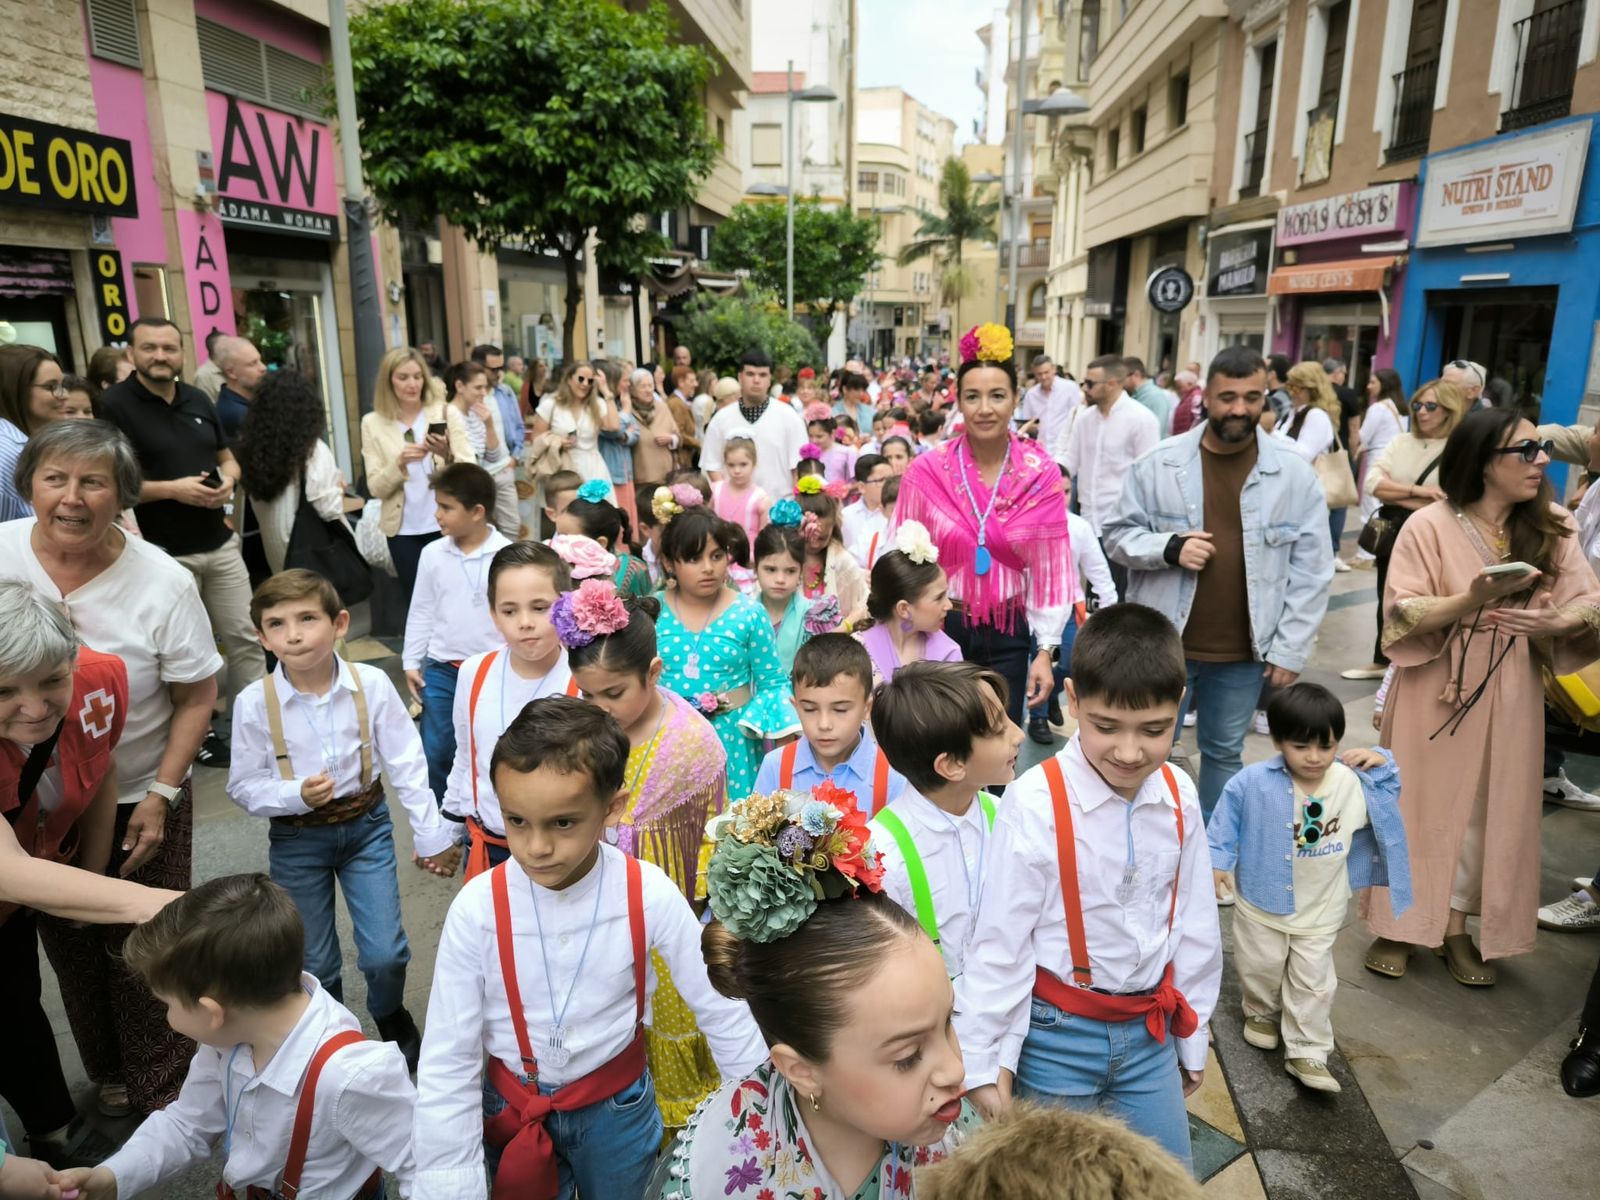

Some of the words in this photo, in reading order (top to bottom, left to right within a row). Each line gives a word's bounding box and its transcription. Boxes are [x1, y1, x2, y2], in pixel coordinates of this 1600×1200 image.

[48, 137, 128, 206] ORO
[217, 95, 320, 209] AW
[1441, 175, 1493, 207] NUTRI
[1495, 163, 1553, 199] STAND
[282, 212, 332, 231] WOMAN
[1283, 206, 1329, 238] MODAS
[97, 254, 126, 336] ORO
[1296, 841, 1344, 858] mucho
